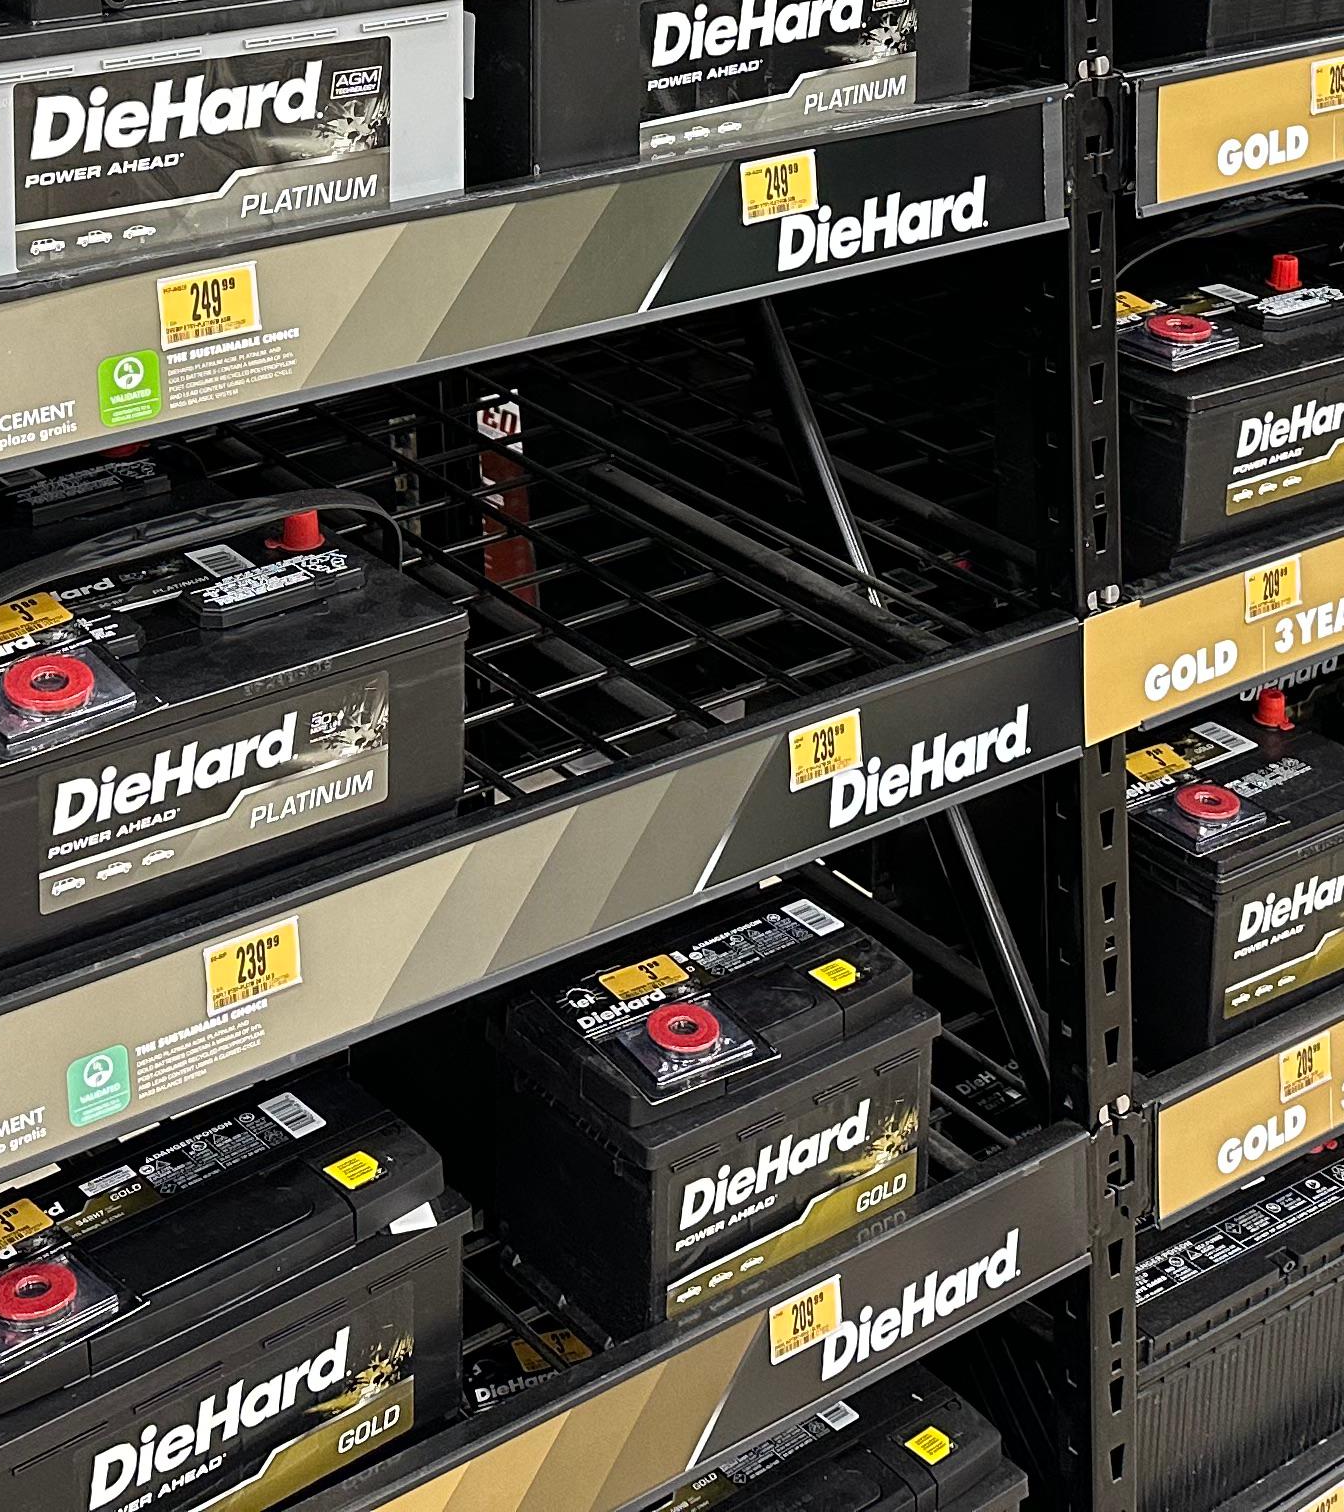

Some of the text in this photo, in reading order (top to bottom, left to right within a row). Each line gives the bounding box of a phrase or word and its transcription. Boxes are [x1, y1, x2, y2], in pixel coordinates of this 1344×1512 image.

[29, 60, 320, 162] DieHard
[1217, 124, 1309, 177] GOLD
[240, 174, 378, 218] PLATINUM
[778, 175, 987, 273] DieHard
[1144, 639, 1238, 702] GOLD
[52, 712, 297, 836] DieHard
[828, 705, 1028, 828] DieHard
[6, 1126, 47, 1152] gratis
[678, 1100, 869, 1230] DieHard
[1217, 1105, 1306, 1173] GOLD
[857, 1172, 907, 1212] GOLD
[821, 1229, 1021, 1381] DieHard
[90, 1328, 350, 1511] DieHard
[337, 1405, 401, 1453] GOLD
